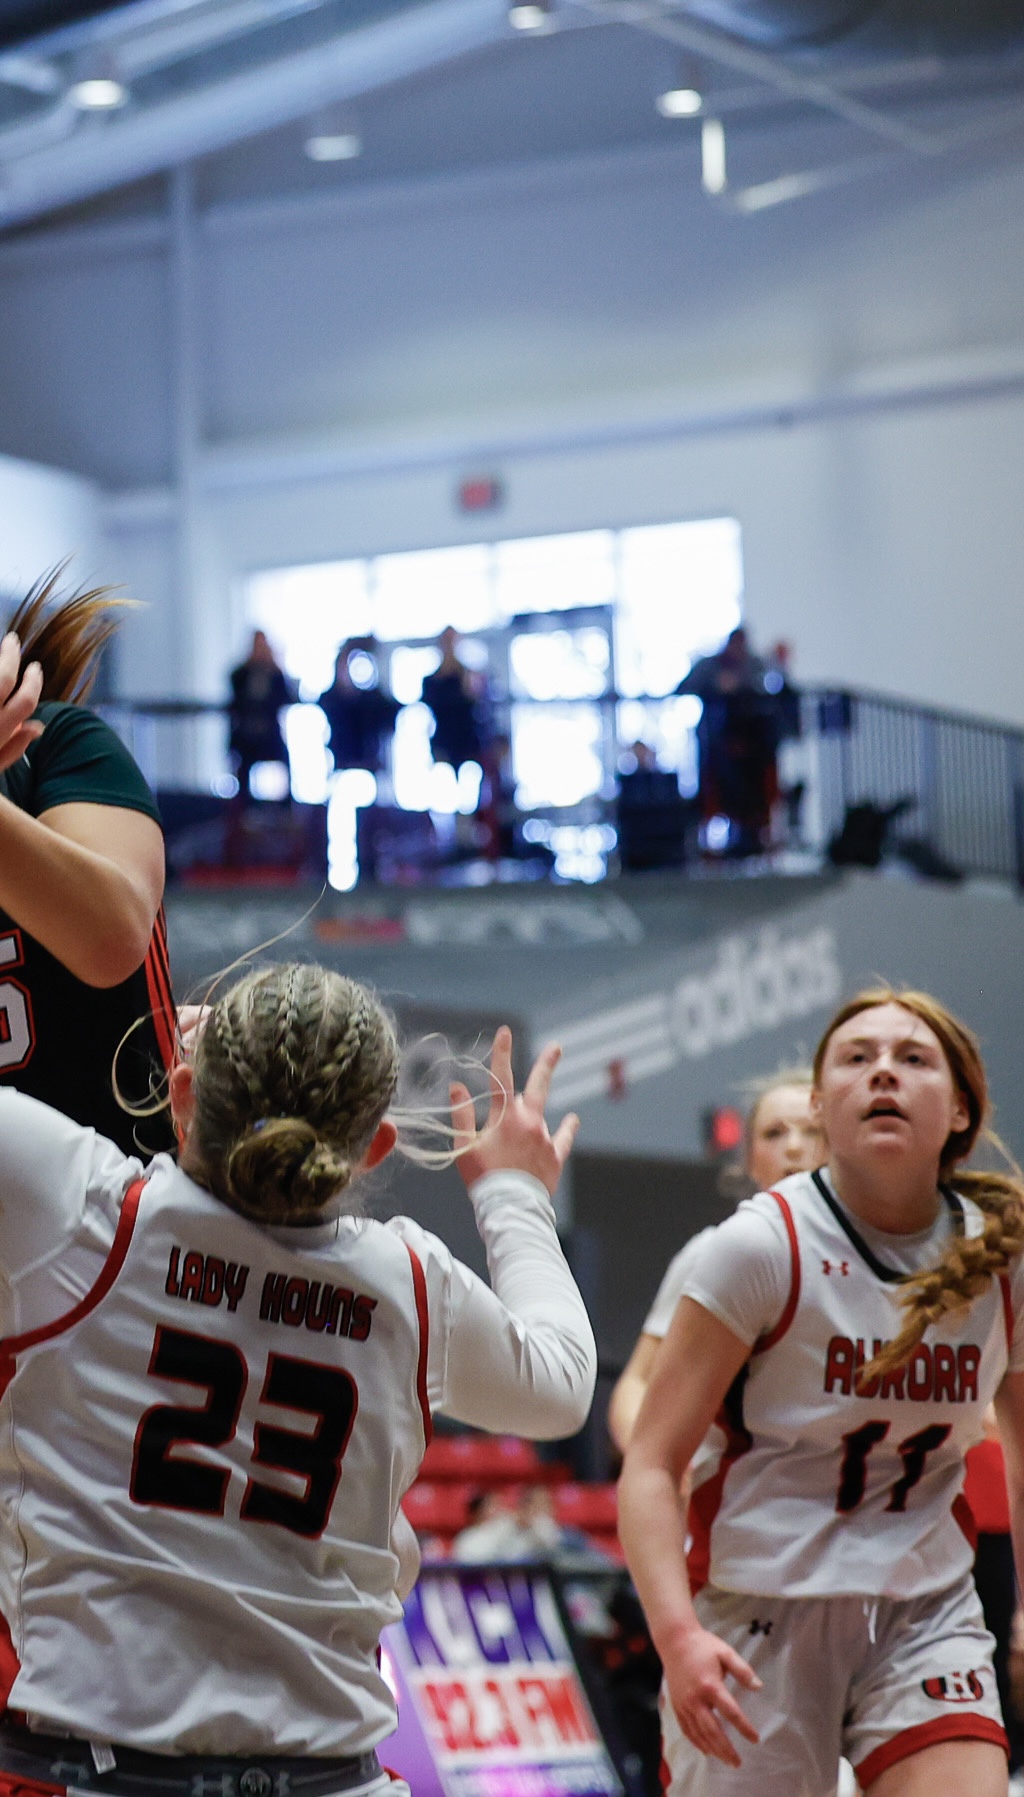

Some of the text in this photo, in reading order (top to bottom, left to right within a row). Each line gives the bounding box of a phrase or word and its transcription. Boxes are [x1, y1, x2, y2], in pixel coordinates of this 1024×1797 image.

[674, 925, 842, 1055] adidas
[165, 1245, 378, 1342] LADY HOUNS
[129, 1323, 359, 1541] 23
[836, 1420, 953, 1514] 11
